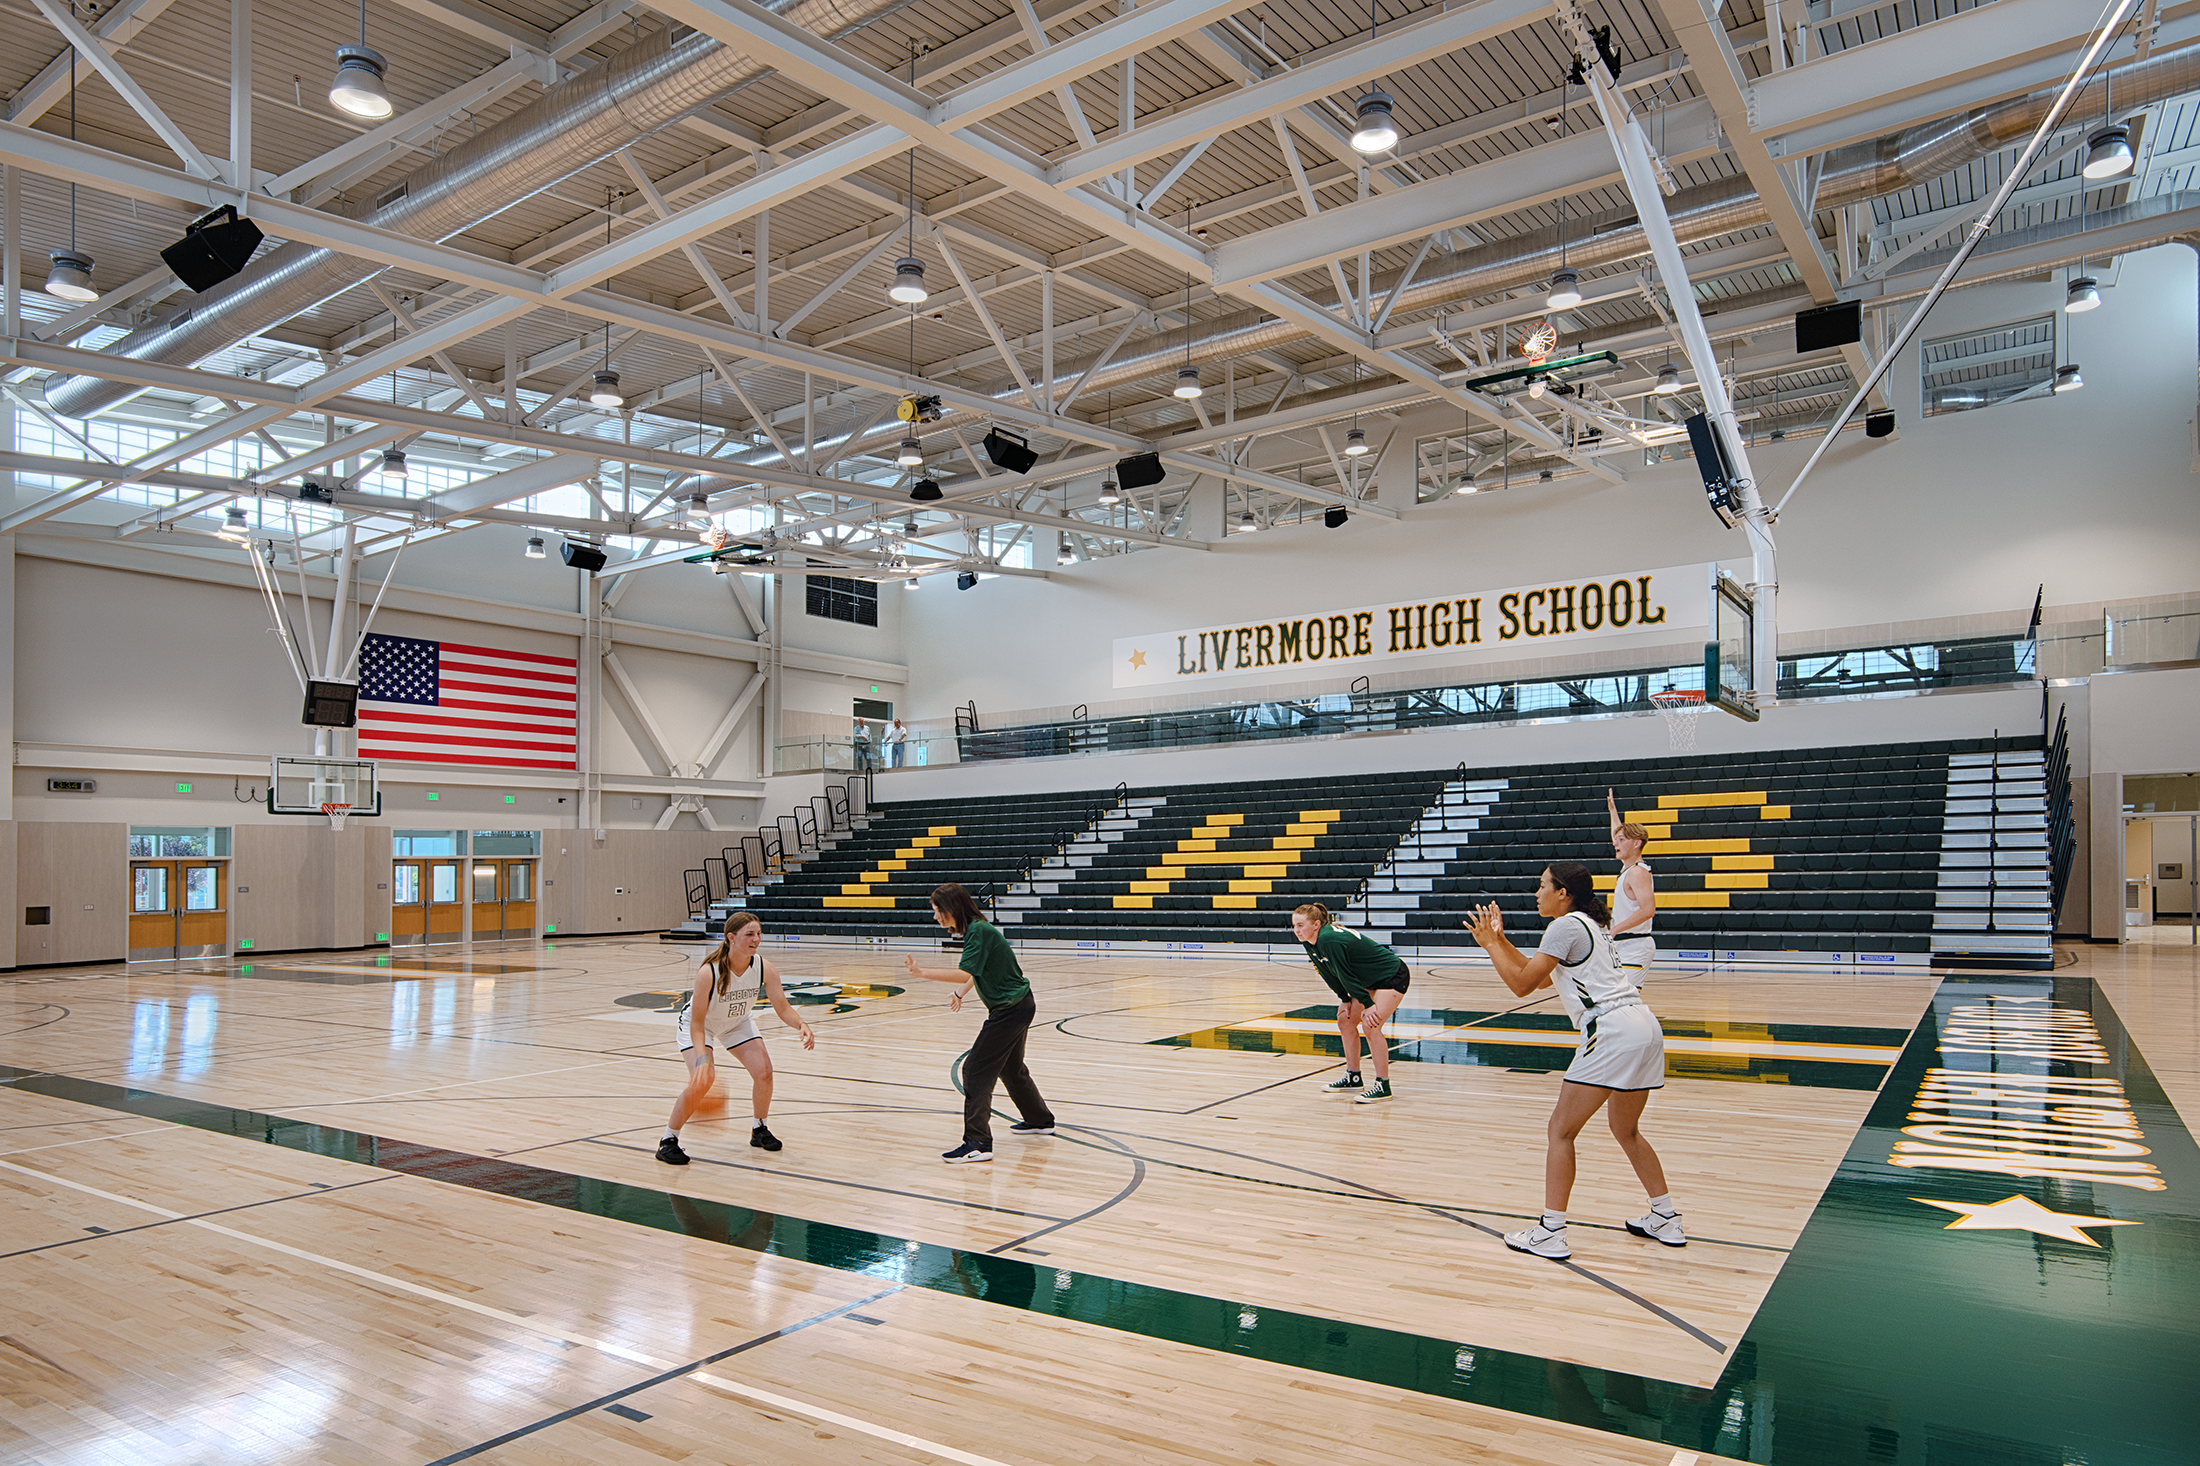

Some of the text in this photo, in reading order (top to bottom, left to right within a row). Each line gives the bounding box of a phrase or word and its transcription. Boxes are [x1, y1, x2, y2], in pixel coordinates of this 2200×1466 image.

[1177, 575, 1667, 675] LIVERMORE HIGH SCHOOL
[728, 1002, 747, 1017] 21
[1887, 1006, 2167, 1191] COWBOY NATION
